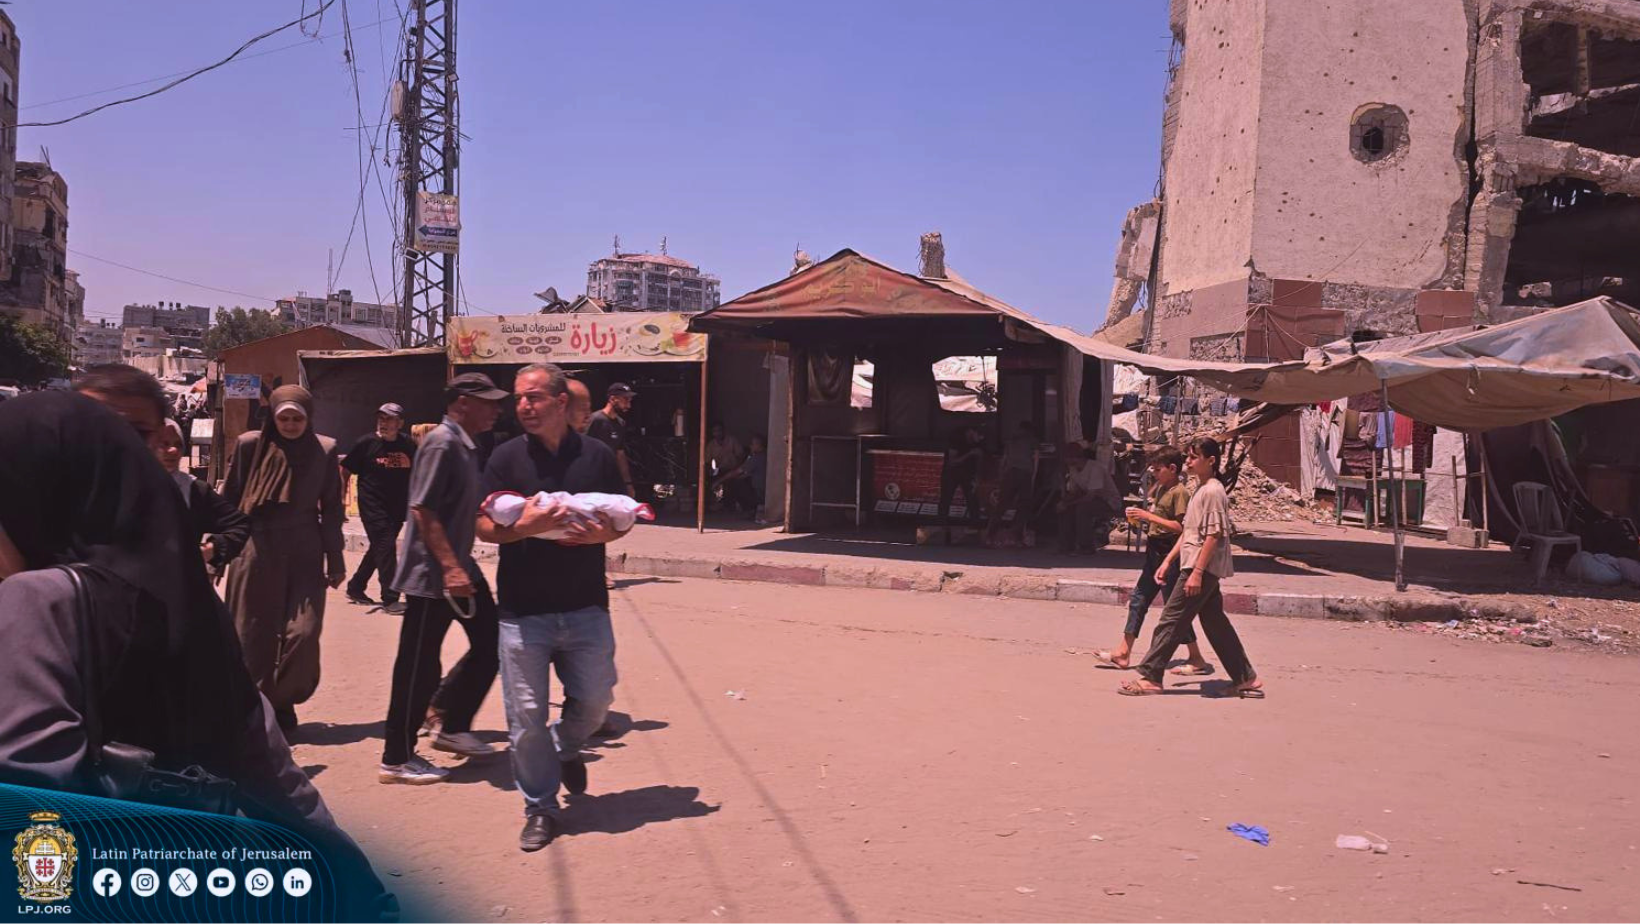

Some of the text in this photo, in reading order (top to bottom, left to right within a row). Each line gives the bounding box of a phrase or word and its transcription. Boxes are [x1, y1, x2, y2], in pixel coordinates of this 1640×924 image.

[501, 322, 566, 334] للمشروبات الساخنة
[570, 321, 617, 356] زيارة
